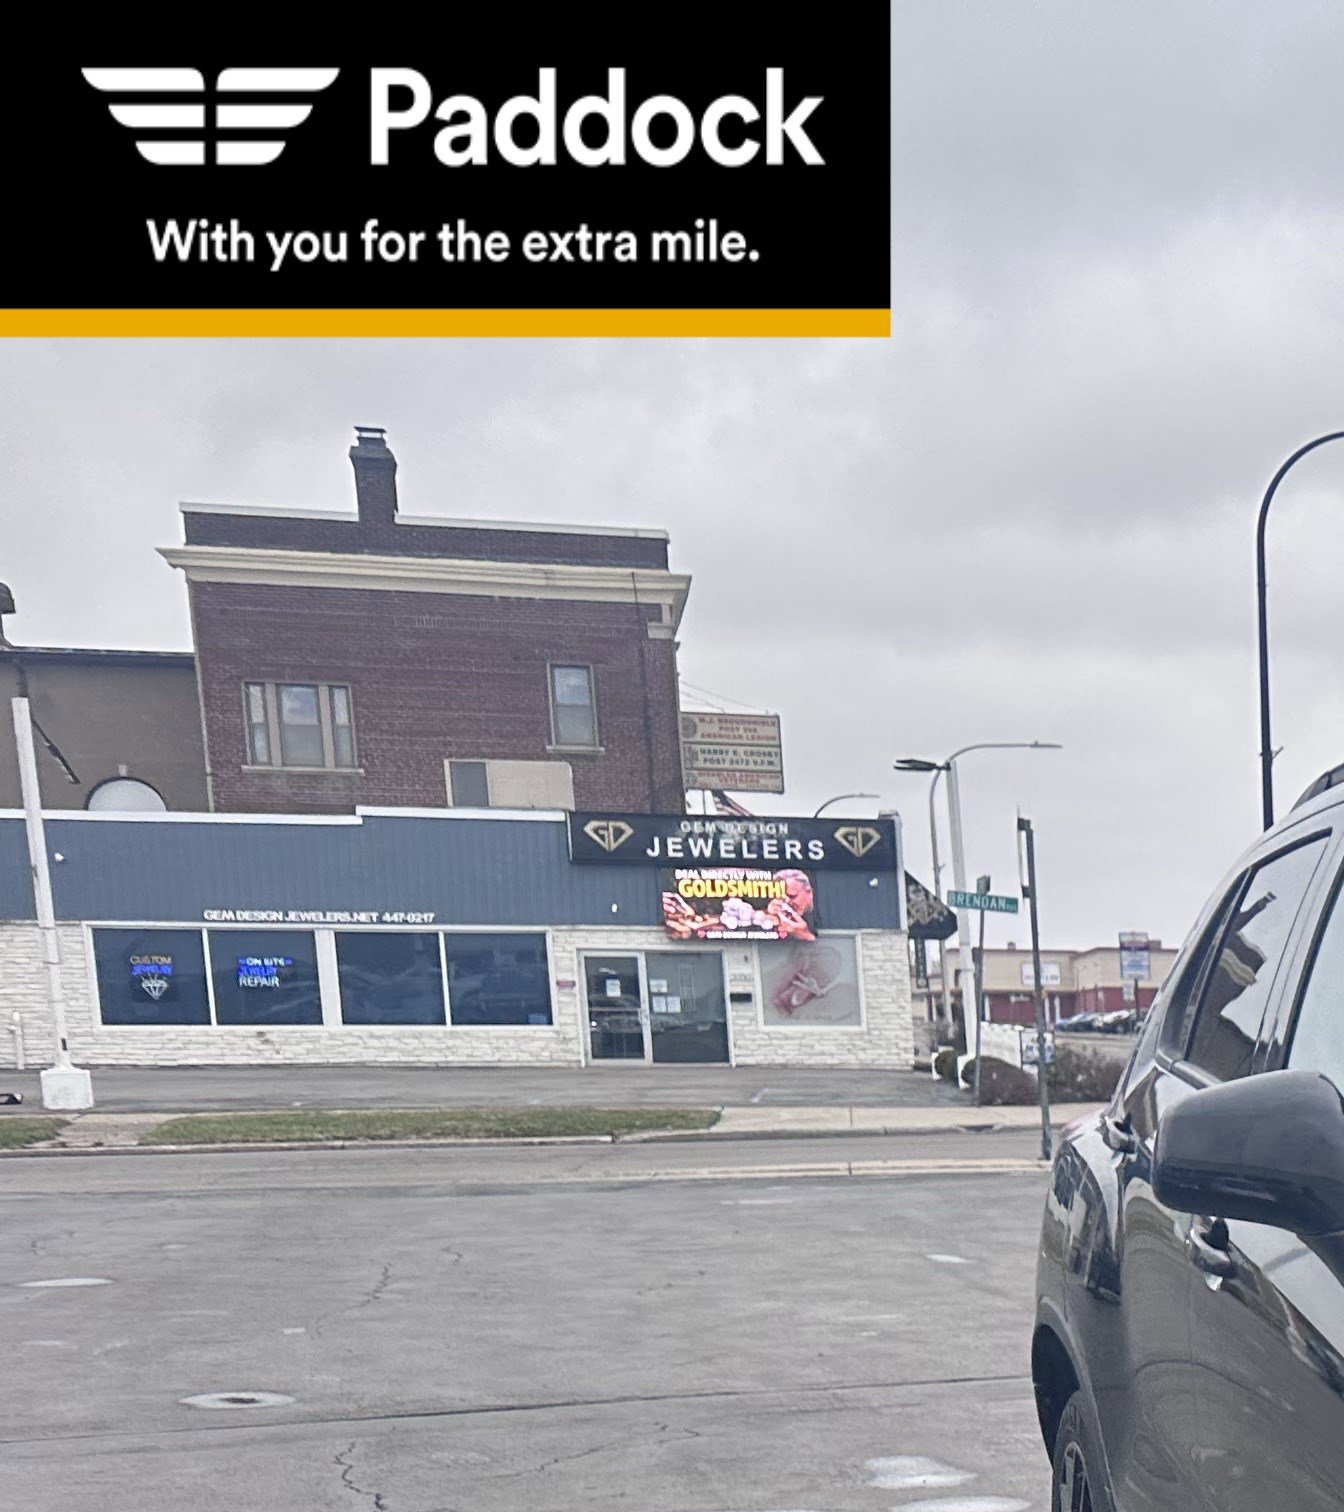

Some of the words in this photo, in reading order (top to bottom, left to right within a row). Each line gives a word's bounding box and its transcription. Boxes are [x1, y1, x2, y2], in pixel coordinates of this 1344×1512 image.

[646, 836, 825, 860] JEWELERS
[678, 879, 786, 899] GOLDSMITH!
[948, 891, 1006, 910] BRENDAN
[203, 909, 236, 921] GEM
[236, 909, 283, 921] DESIGN
[239, 975, 280, 988] REPAIR
